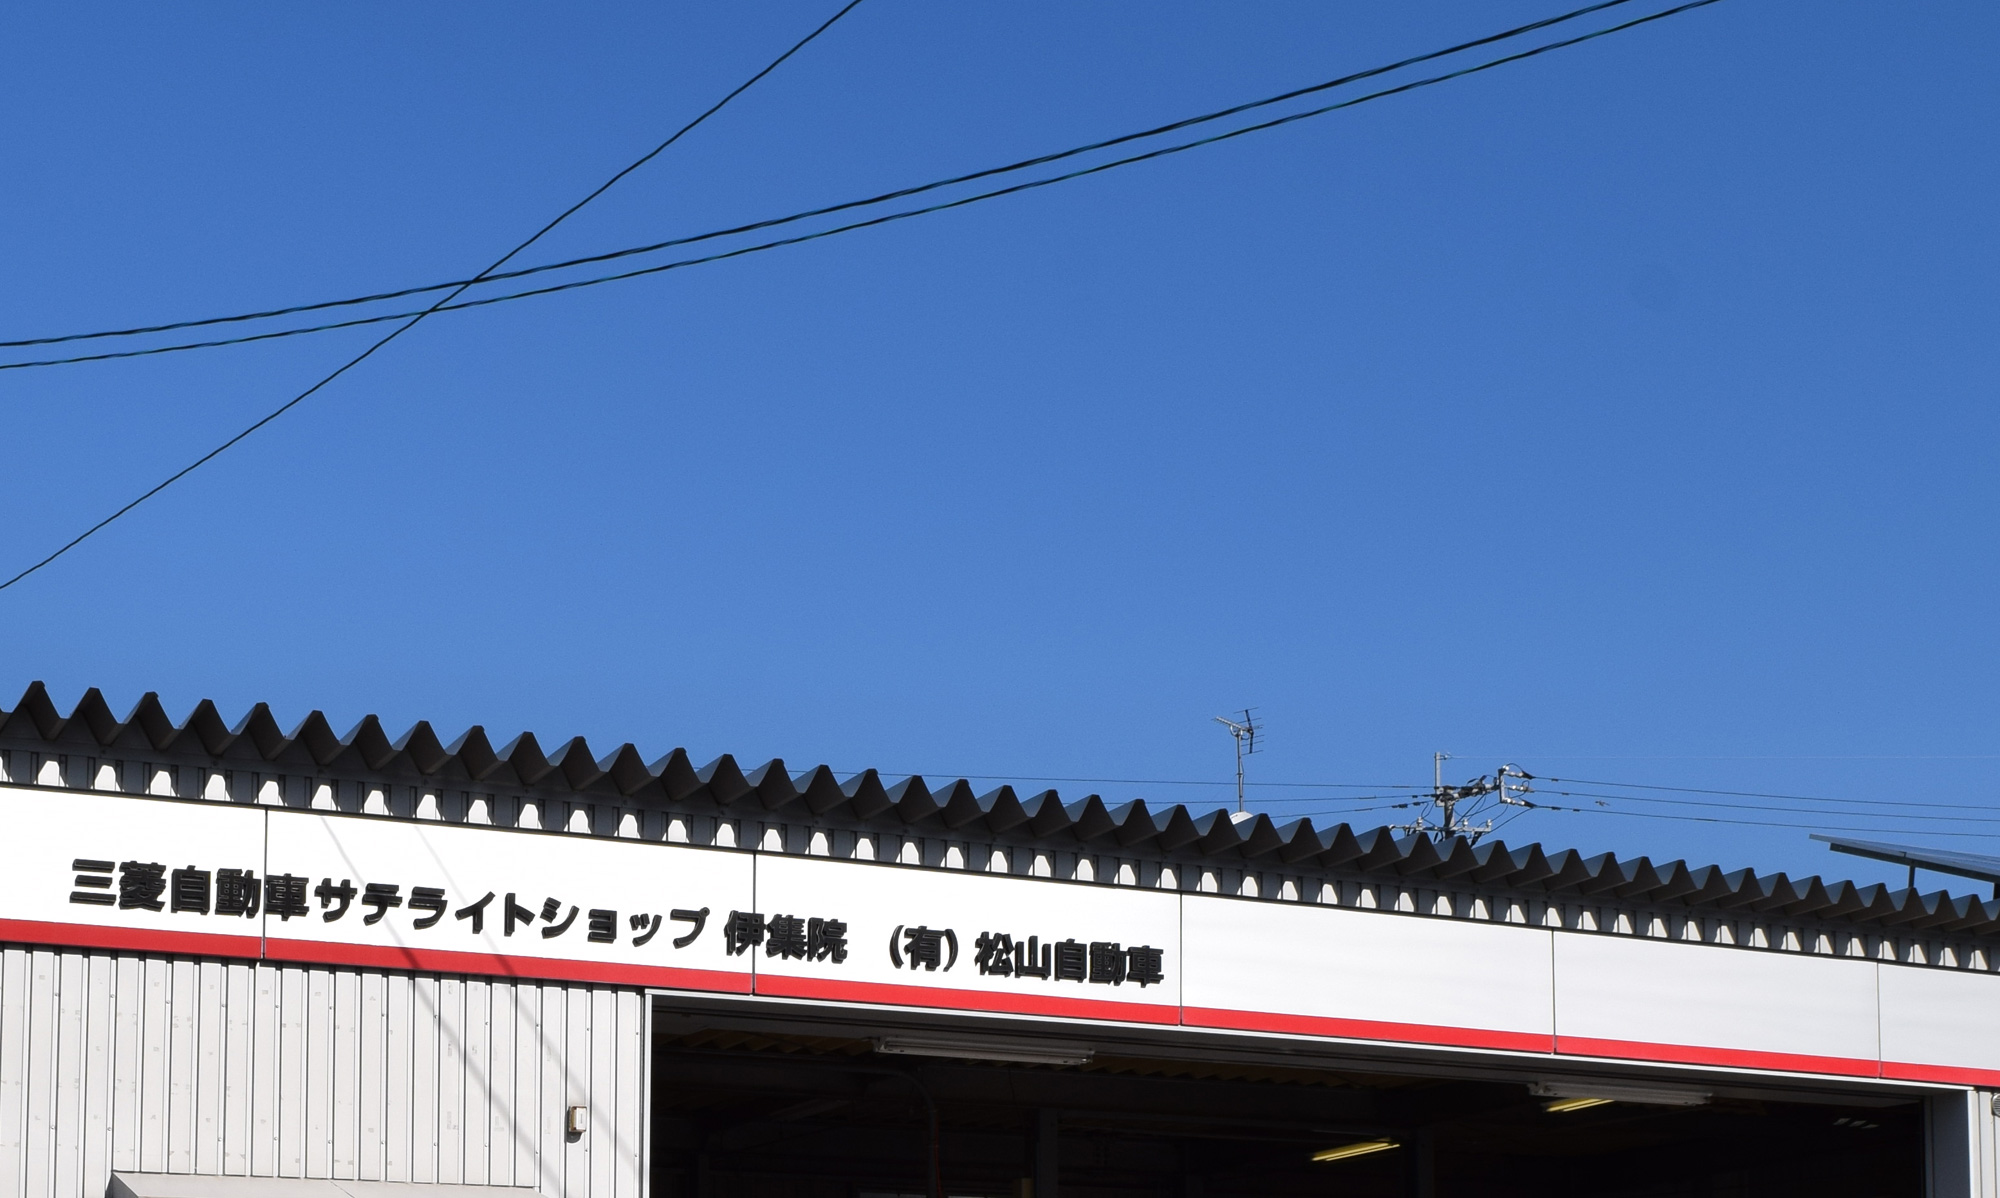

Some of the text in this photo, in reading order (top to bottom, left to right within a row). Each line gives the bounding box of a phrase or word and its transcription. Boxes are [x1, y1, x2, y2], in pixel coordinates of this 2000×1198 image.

[70, 858, 710, 949] 三菱自動車サテライトショップ
[723, 910, 848, 964] 伊集院
